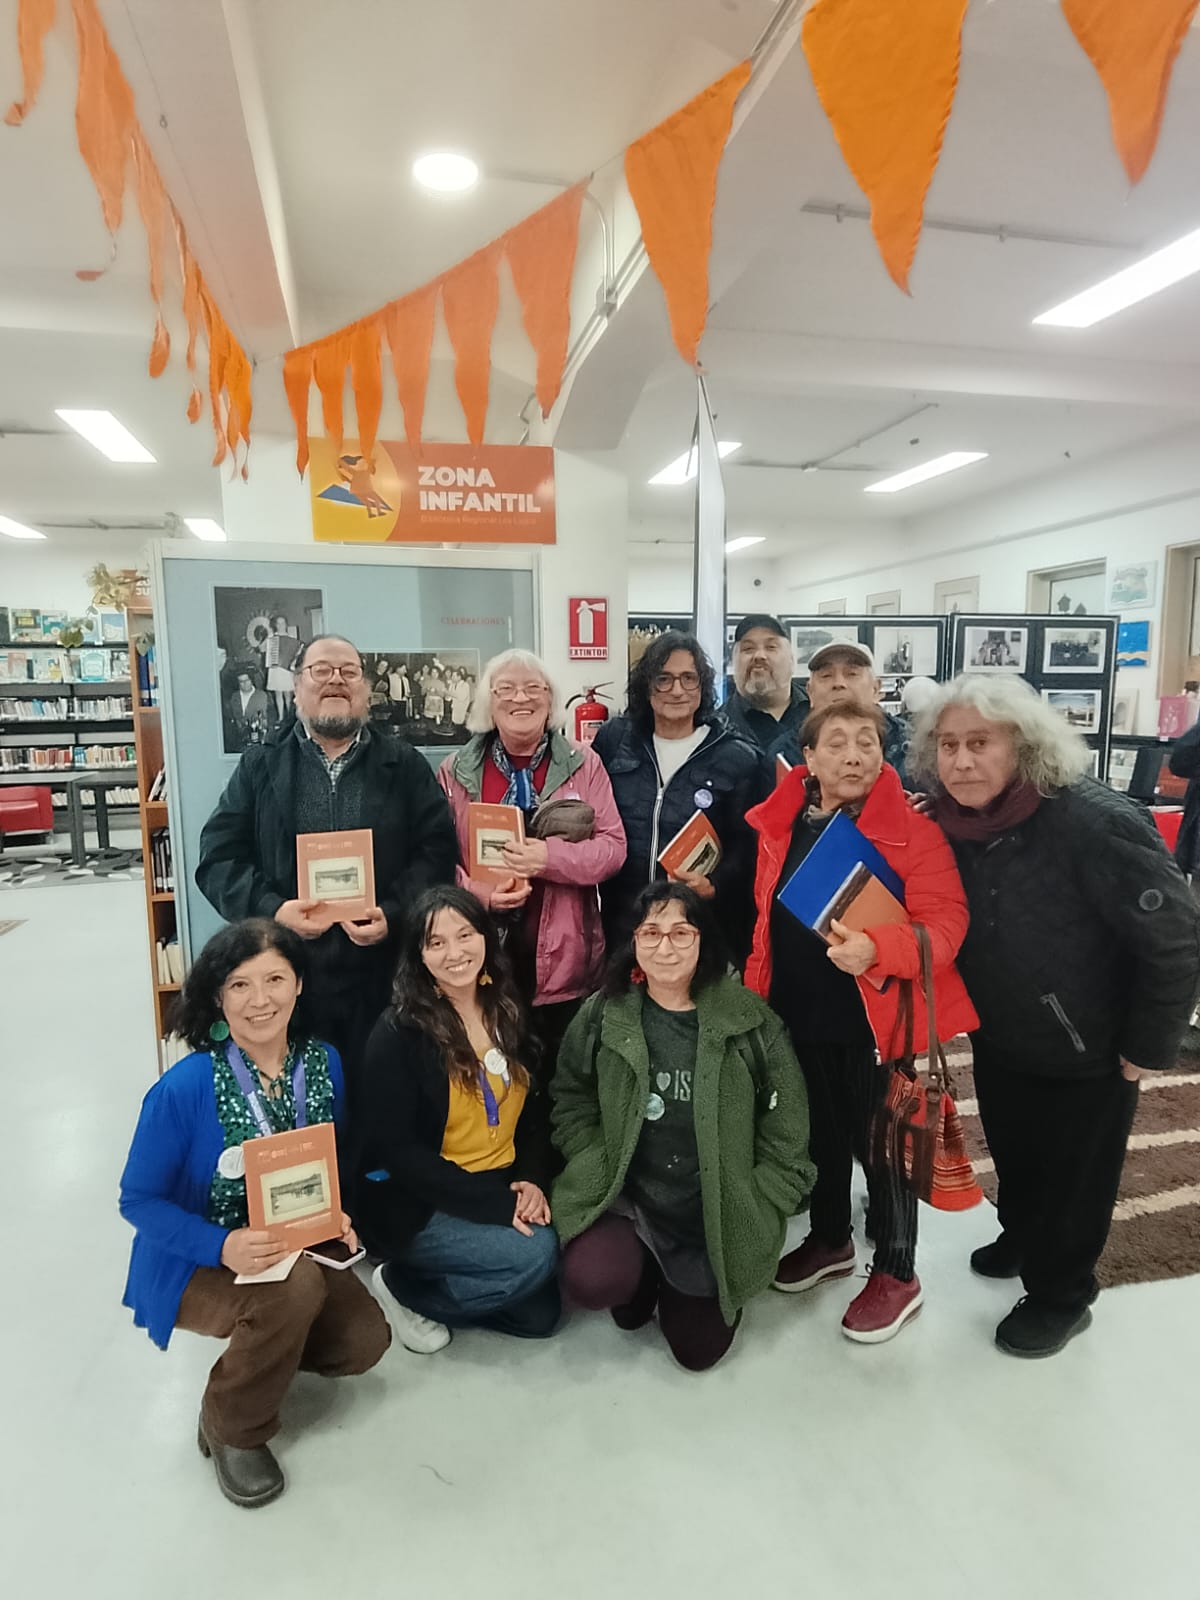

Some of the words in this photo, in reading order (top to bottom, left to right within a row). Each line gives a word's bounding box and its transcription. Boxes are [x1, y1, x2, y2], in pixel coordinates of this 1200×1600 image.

[418, 466, 496, 487] ZONA
[419, 490, 541, 513] INFANTIL
[440, 616, 506, 625] CELEBRACIONES
[569, 648, 608, 657] EXTINTOR
